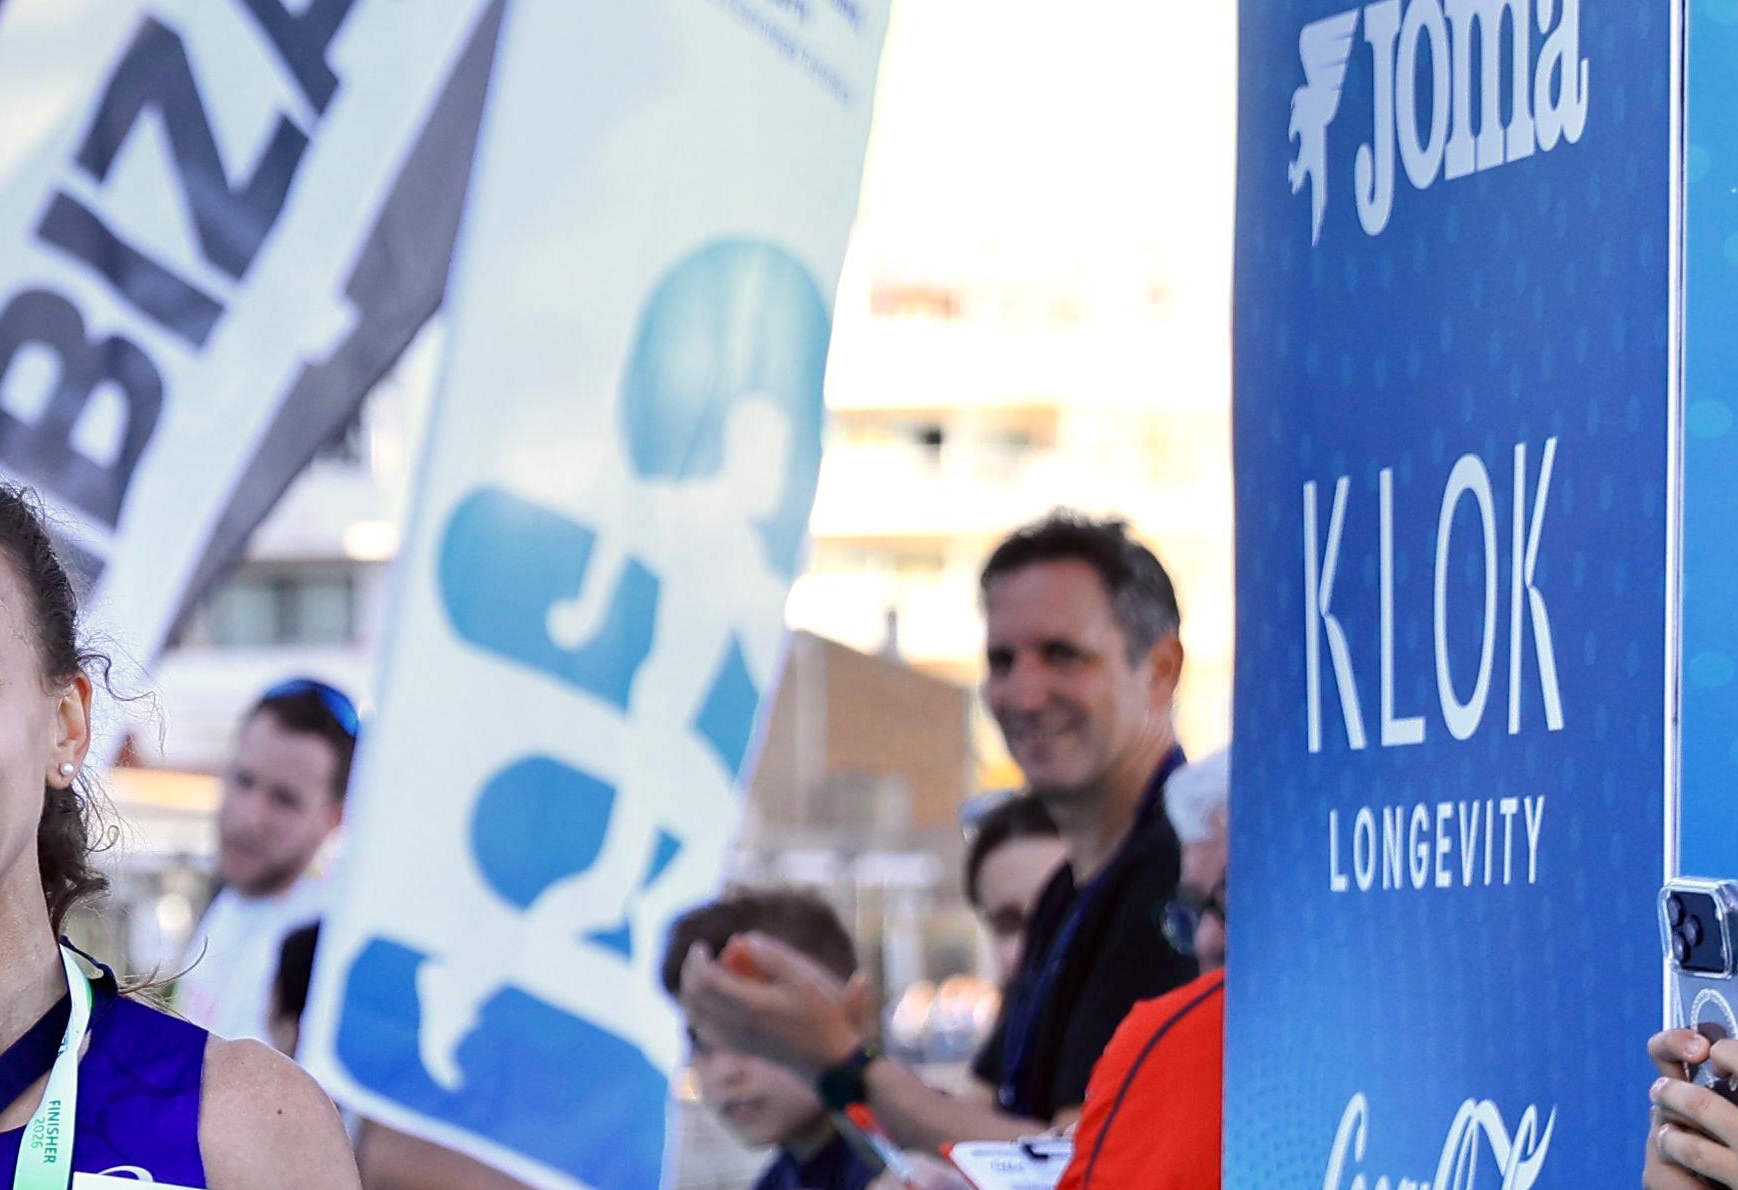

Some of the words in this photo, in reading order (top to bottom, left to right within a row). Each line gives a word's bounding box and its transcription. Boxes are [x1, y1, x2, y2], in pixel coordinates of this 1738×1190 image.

[1302, 436, 1564, 754] KLOK
[1329, 796, 1546, 893] LONGEVITY
[31, 1118, 45, 1149] 2026
[43, 1100, 61, 1164] FINISHER
